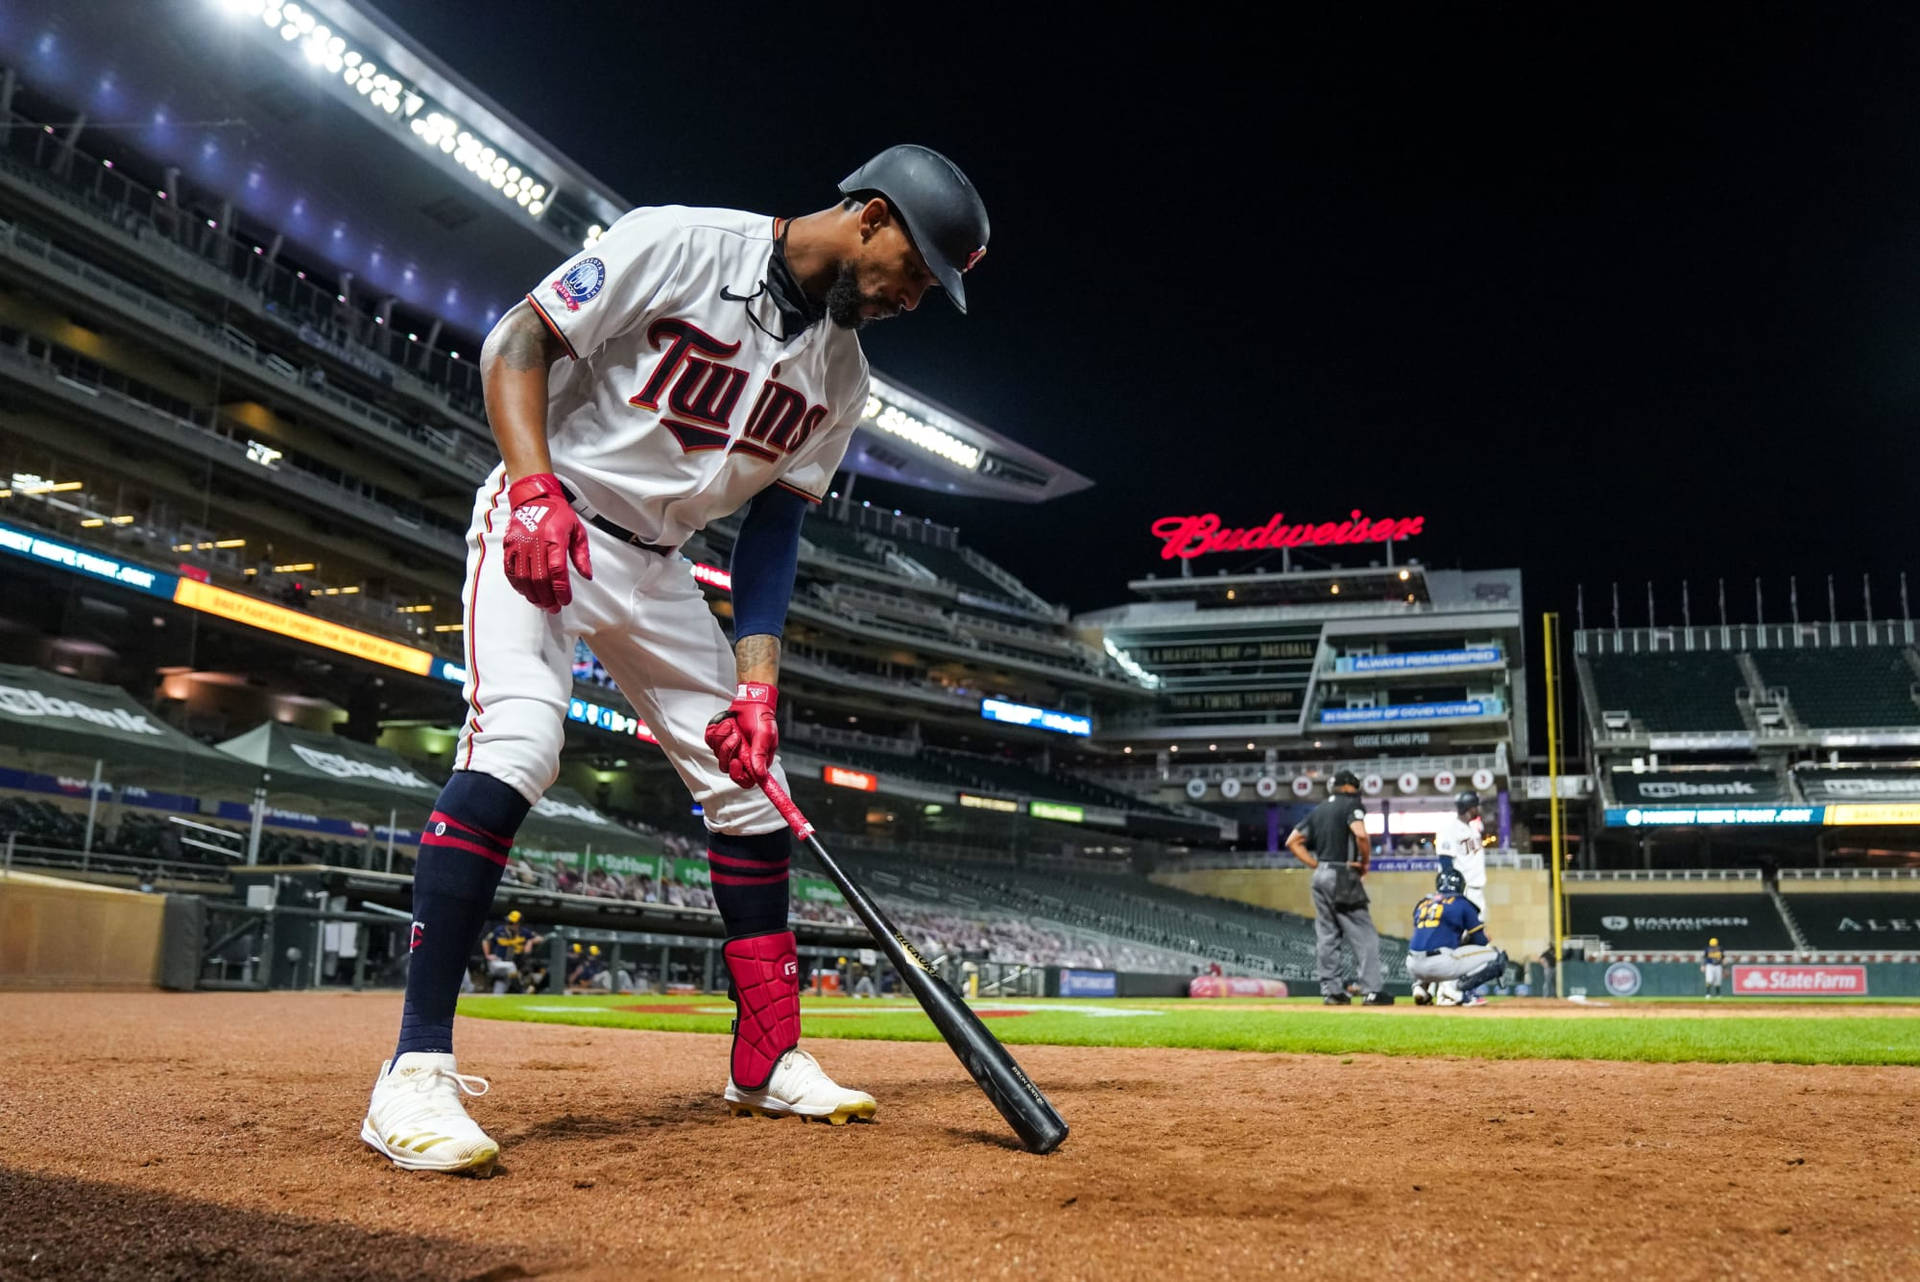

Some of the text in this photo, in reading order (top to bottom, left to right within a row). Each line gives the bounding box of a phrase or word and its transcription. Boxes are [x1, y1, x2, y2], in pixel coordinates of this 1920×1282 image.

[629, 318, 828, 456] Twins
[515, 509, 538, 532] adidas
[1151, 509, 1425, 560] Budweiser
[1260, 643, 1312, 657] BASEBALL
[1356, 651, 1494, 669] ALWAYS REMEMBERED
[28, 690, 166, 735] bank
[1336, 709, 1382, 721] MEMORY
[1384, 708, 1399, 719] OF
[1400, 706, 1434, 718] COVID
[1436, 704, 1481, 716] VICTIMS
[1354, 732, 1430, 747] GOOSE ISLAND PUB
[1680, 781, 1755, 796] bank
[1865, 779, 1920, 794] ban
